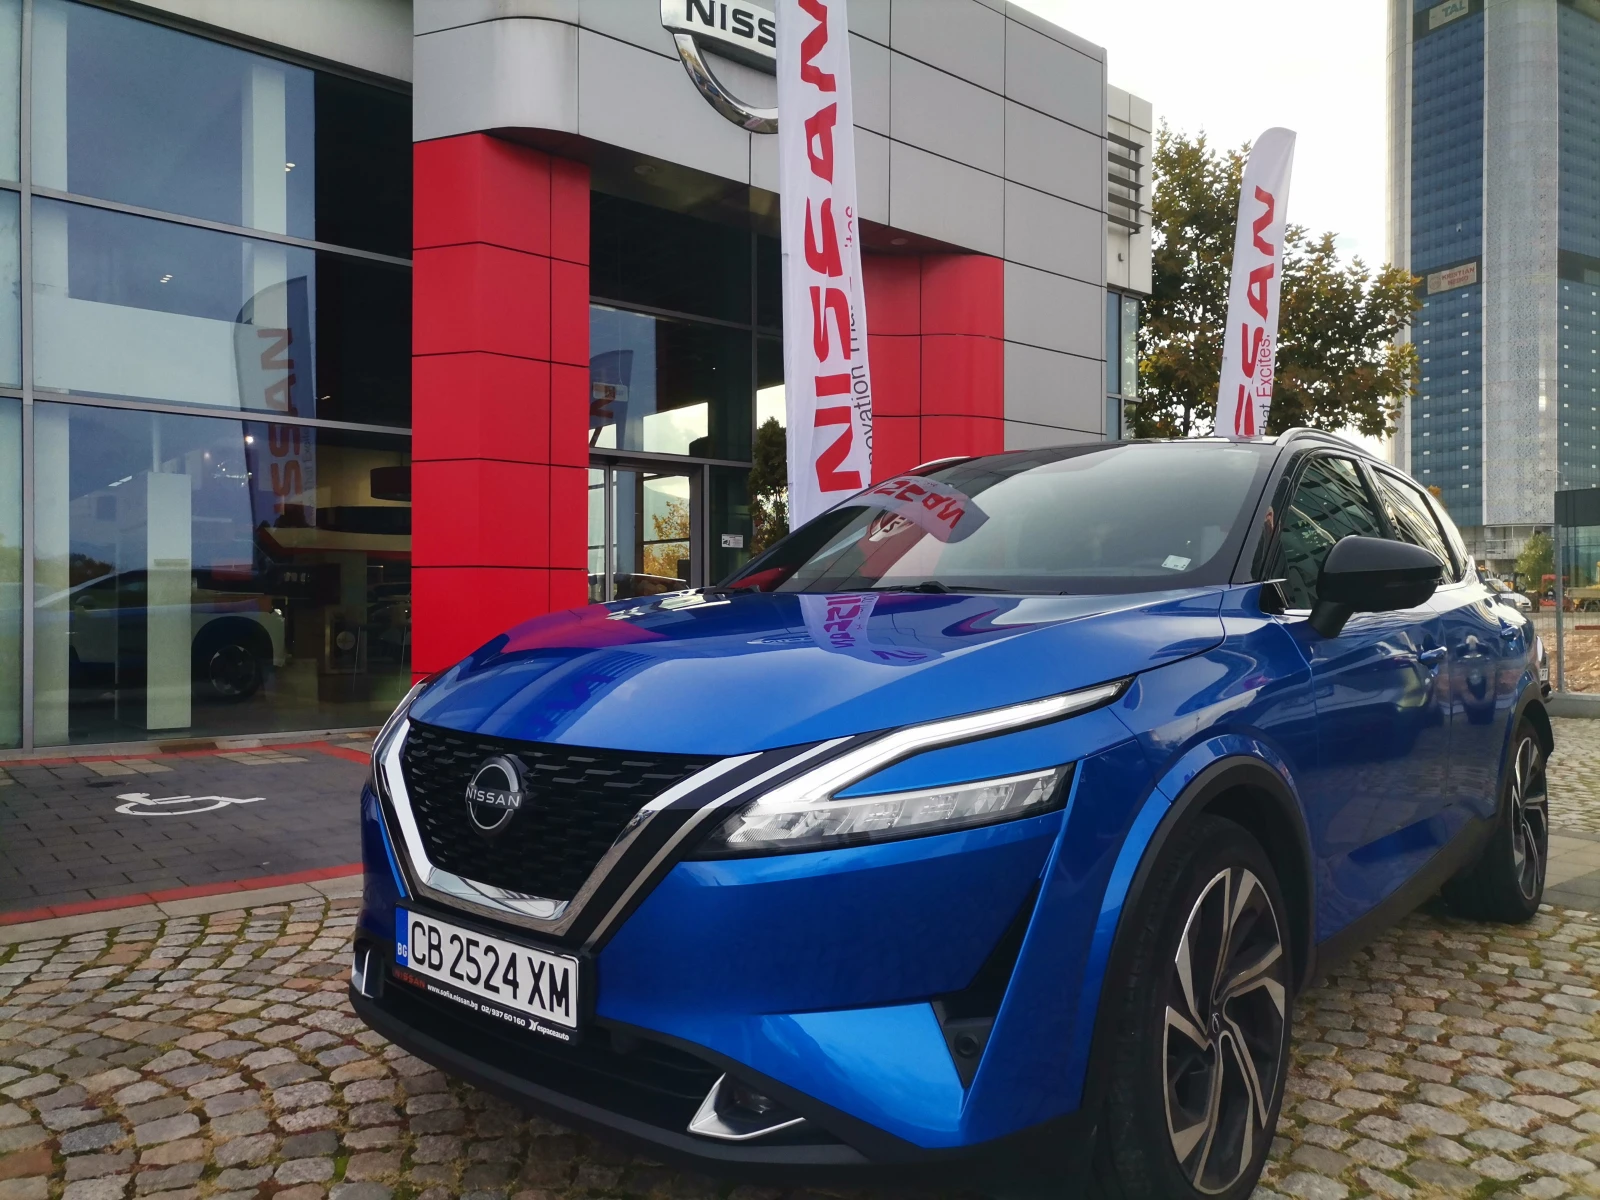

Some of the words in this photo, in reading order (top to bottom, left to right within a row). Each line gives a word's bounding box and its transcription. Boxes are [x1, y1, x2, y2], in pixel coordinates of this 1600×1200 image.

[465, 786, 520, 808] NISSAN
[397, 942, 408, 958] BG
[411, 920, 444, 972] CB
[449, 933, 520, 1001] 2524
[527, 956, 571, 1018] XM
[394, 969, 426, 989] NISSAN
[427, 984, 479, 1011] www.sofia.nissan.bg
[536, 1024, 570, 1041] espaceauto
